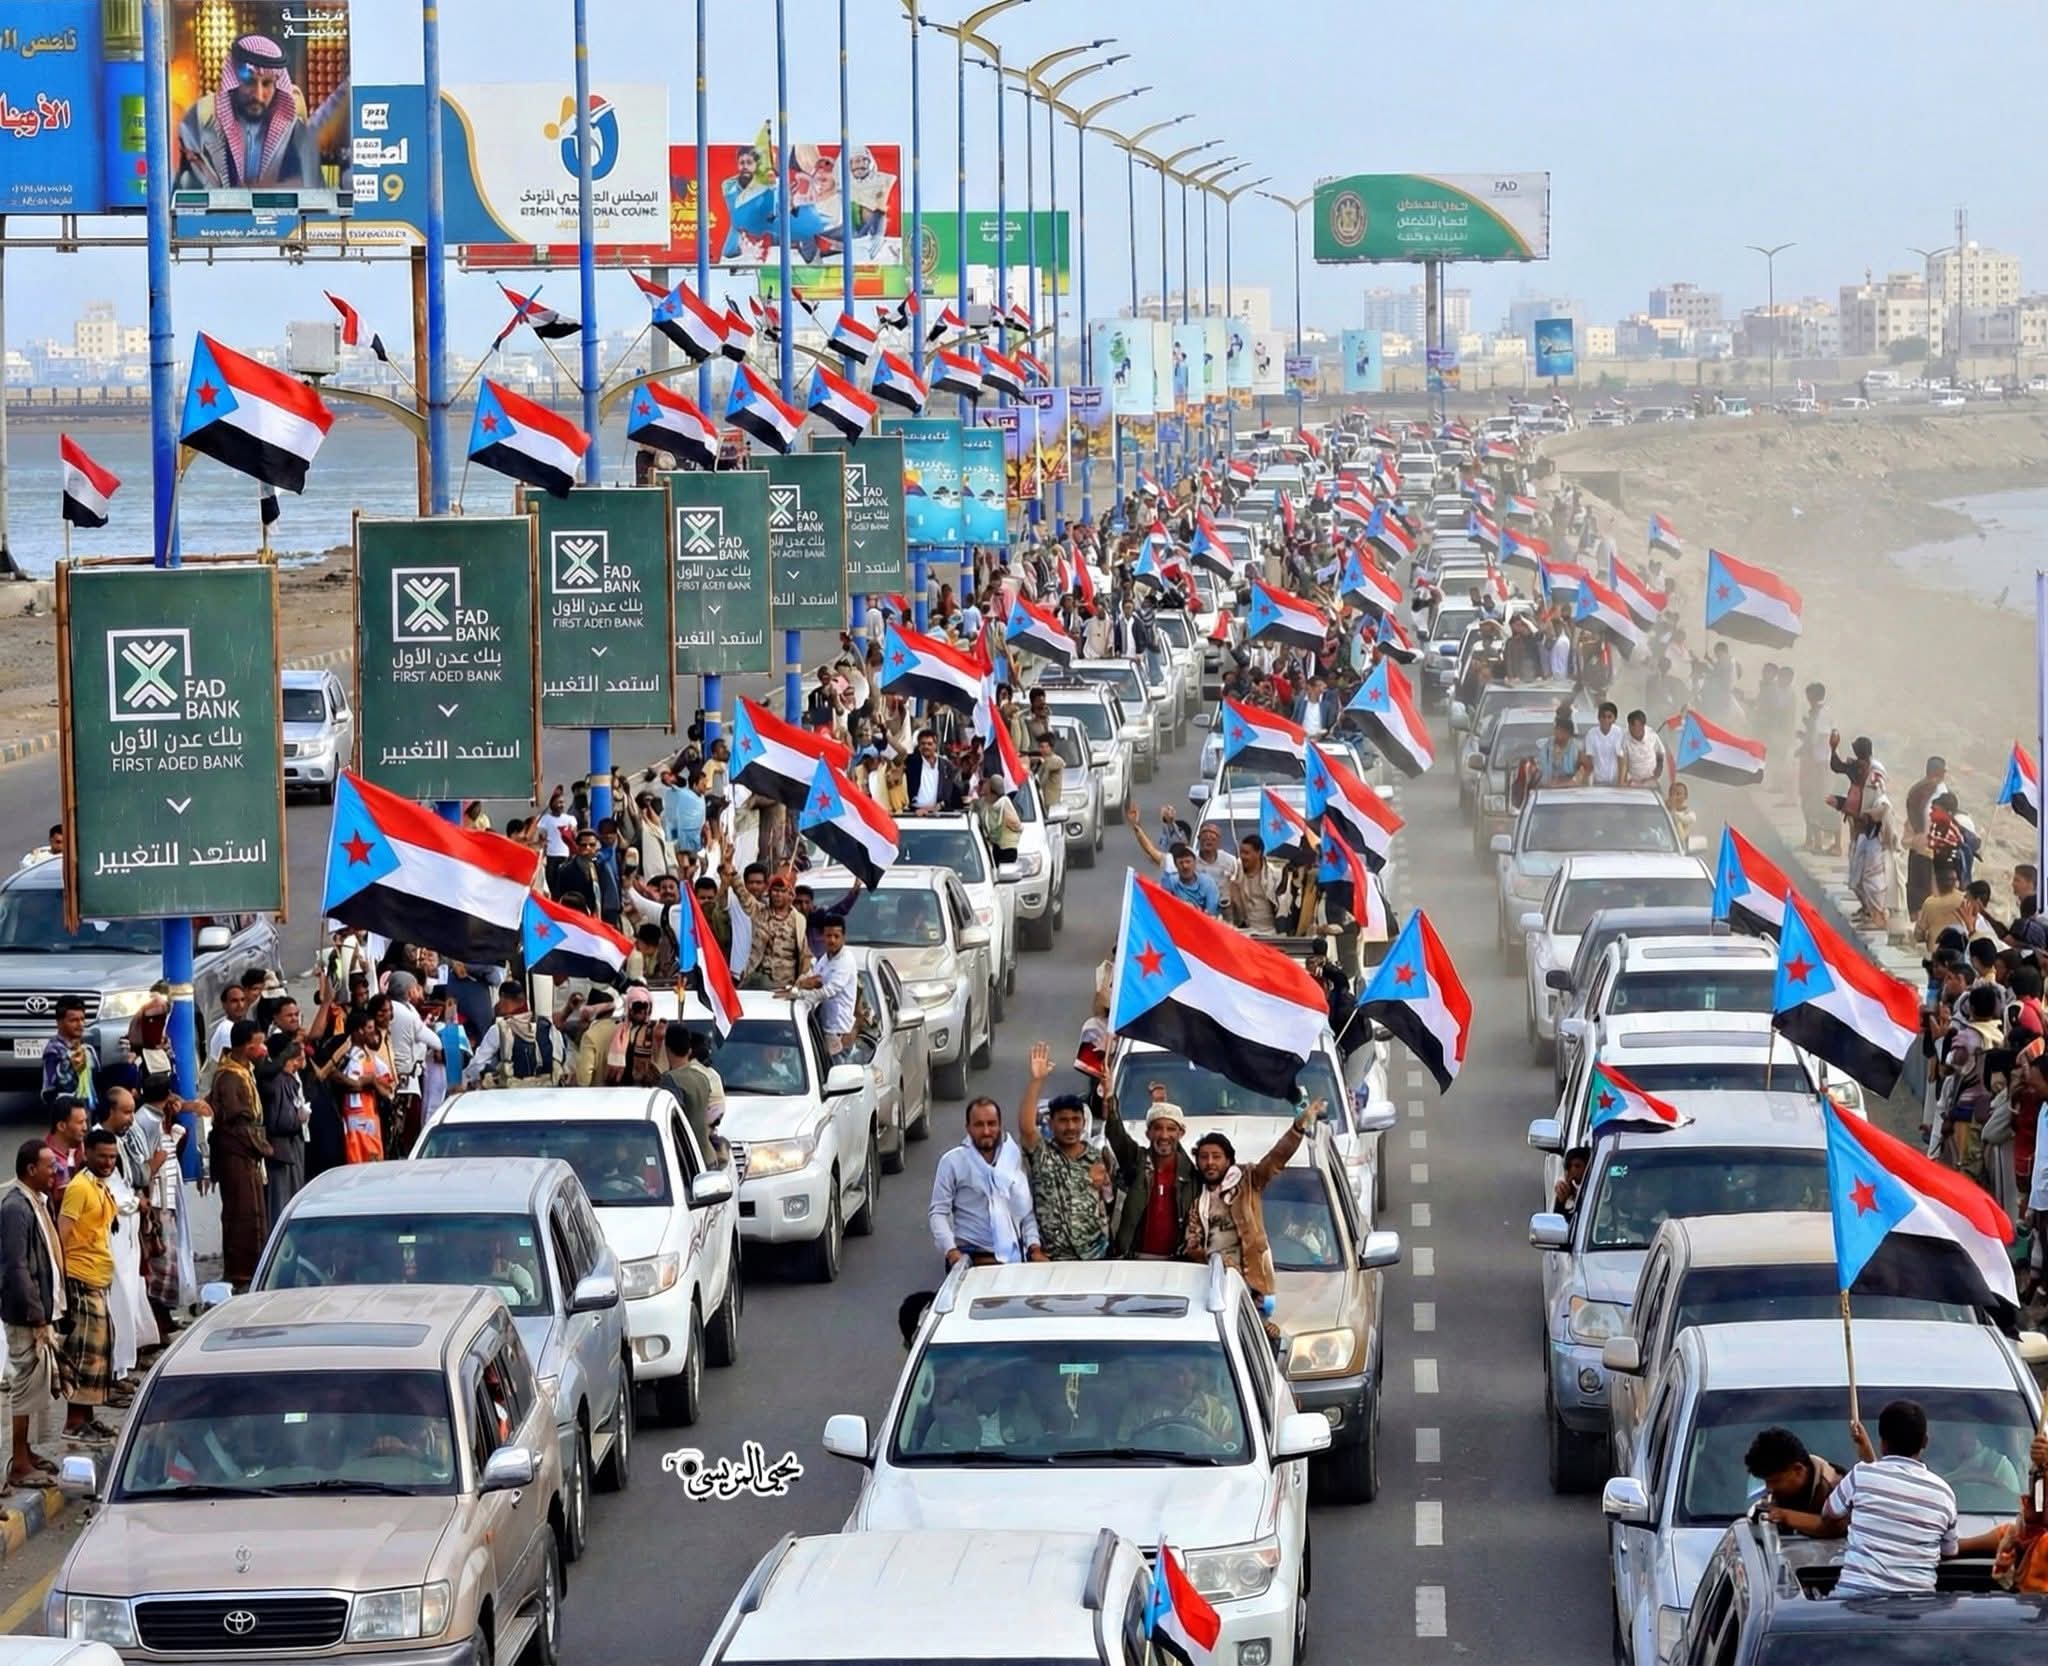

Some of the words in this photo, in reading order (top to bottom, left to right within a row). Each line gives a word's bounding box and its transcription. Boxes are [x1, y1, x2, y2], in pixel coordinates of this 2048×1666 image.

[797, 522, 824, 533] BANK
[718, 536, 743, 549] FAD
[719, 549, 750, 561] BANK
[603, 565, 632, 579] FAD
[603, 580, 641, 593] BANK
[455, 609, 489, 626] FAD
[614, 616, 645, 629] BANK
[455, 626, 501, 642] BANK
[435, 652, 471, 669] عدن
[392, 670, 426, 683] FIRST
[467, 669, 503, 682] BANK
[184, 679, 226, 698] FAD
[185, 699, 241, 720] BANK
[110, 726, 158, 755] الأول
[164, 733, 203, 754] عدن
[112, 757, 155, 772] FIRST
[203, 753, 245, 769] BANK
